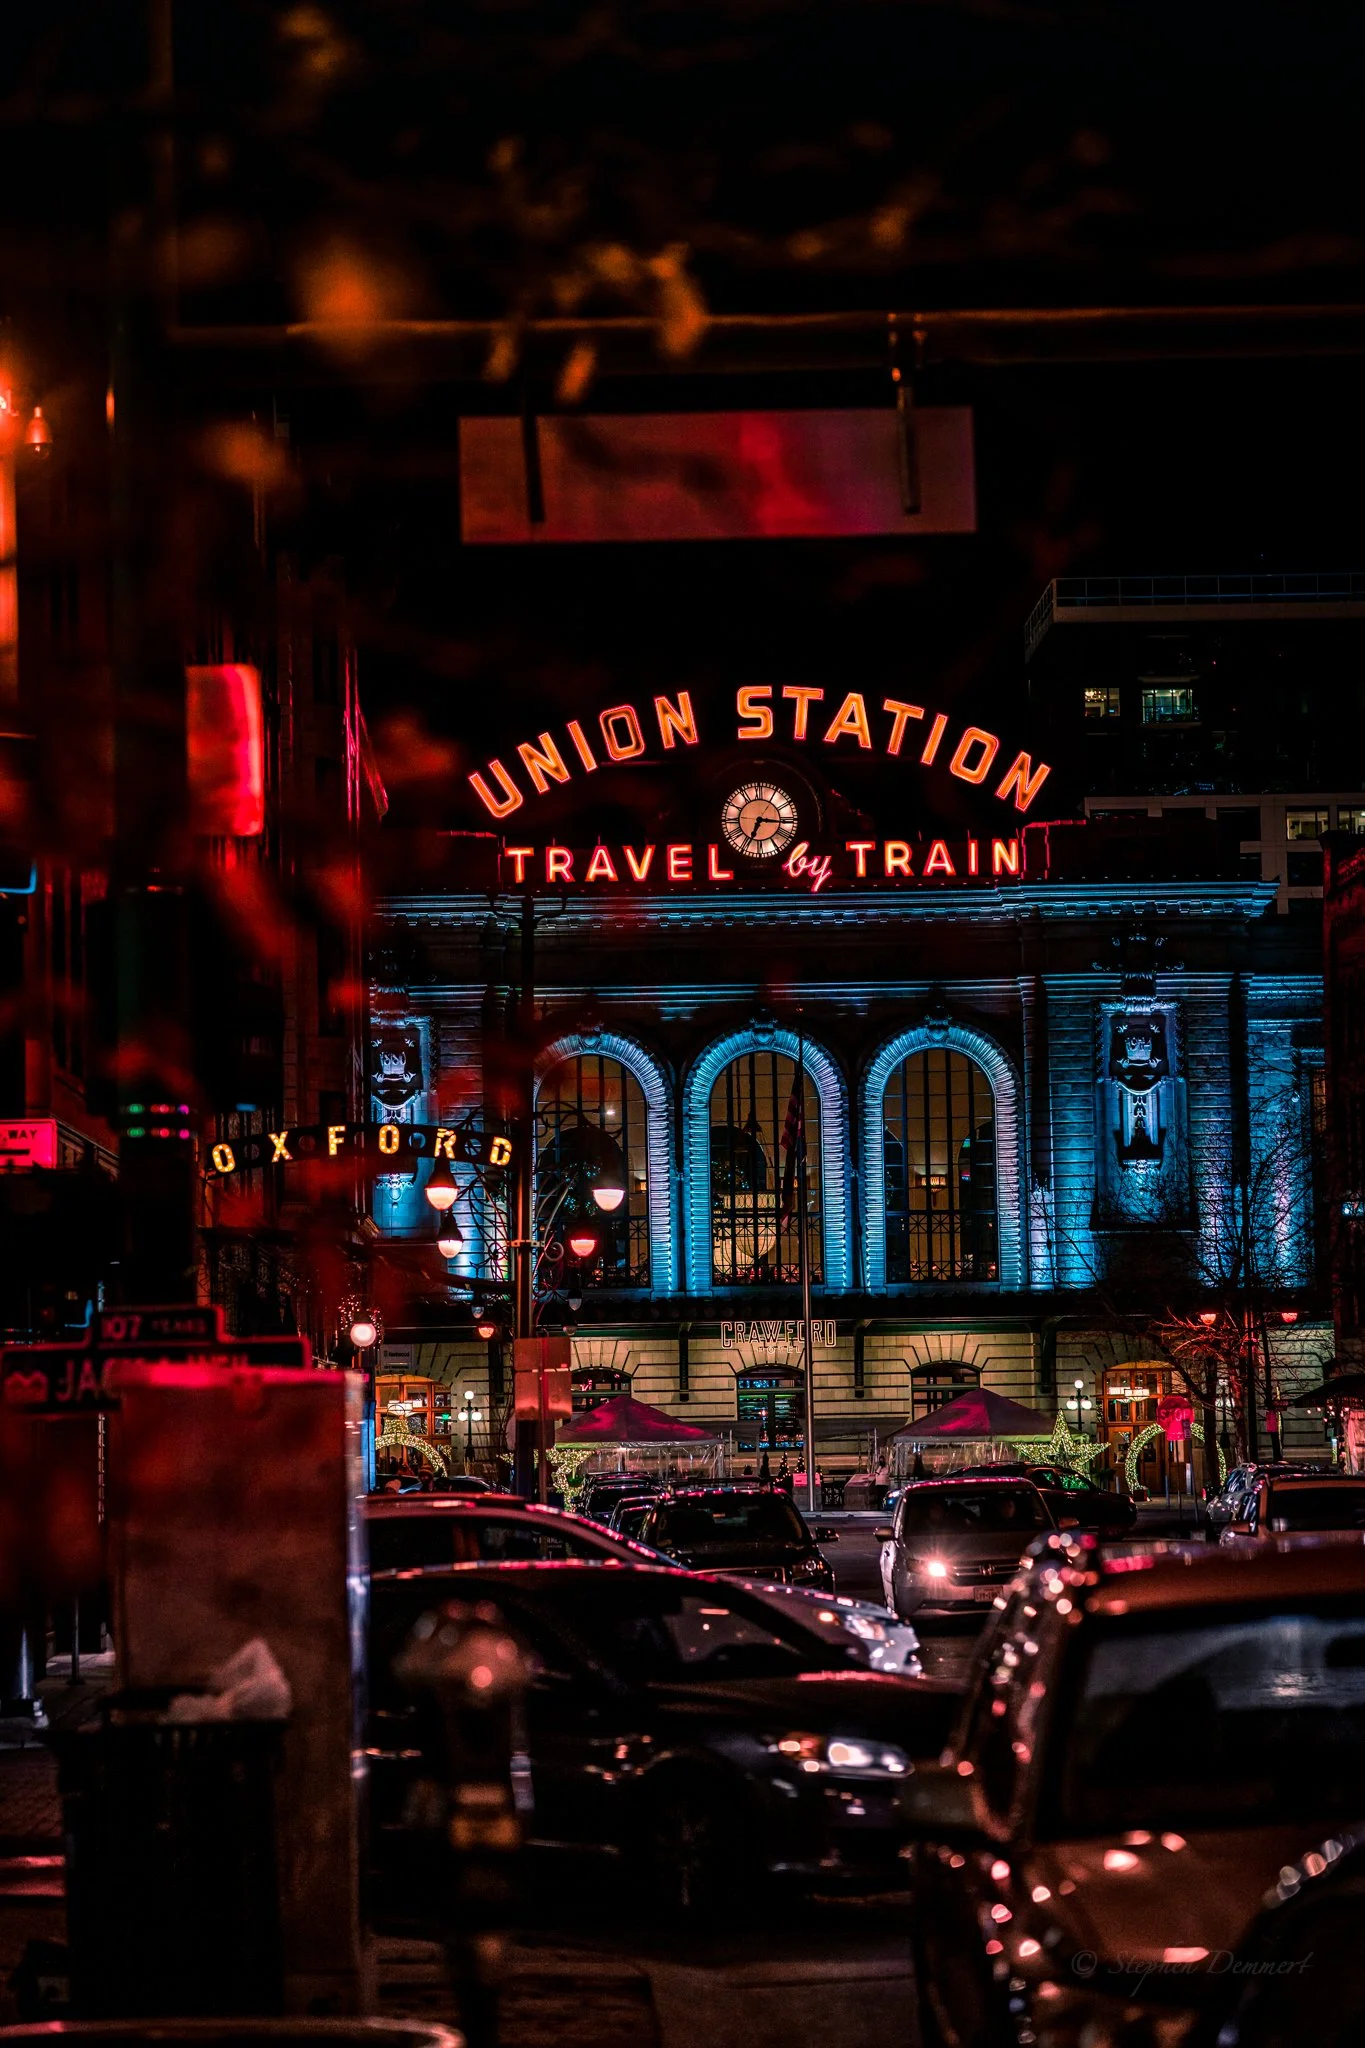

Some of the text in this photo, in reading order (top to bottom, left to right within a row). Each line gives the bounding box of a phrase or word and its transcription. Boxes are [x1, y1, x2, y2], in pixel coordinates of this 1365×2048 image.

[468, 685, 1051, 819] UNION STATION
[504, 839, 1020, 892] TRAVEL by TRAIN
[211, 1124, 513, 1173] OXFORD
[721, 1320, 837, 1349] CRAWFORD
[1160, 1408, 1191, 1421] STOP
